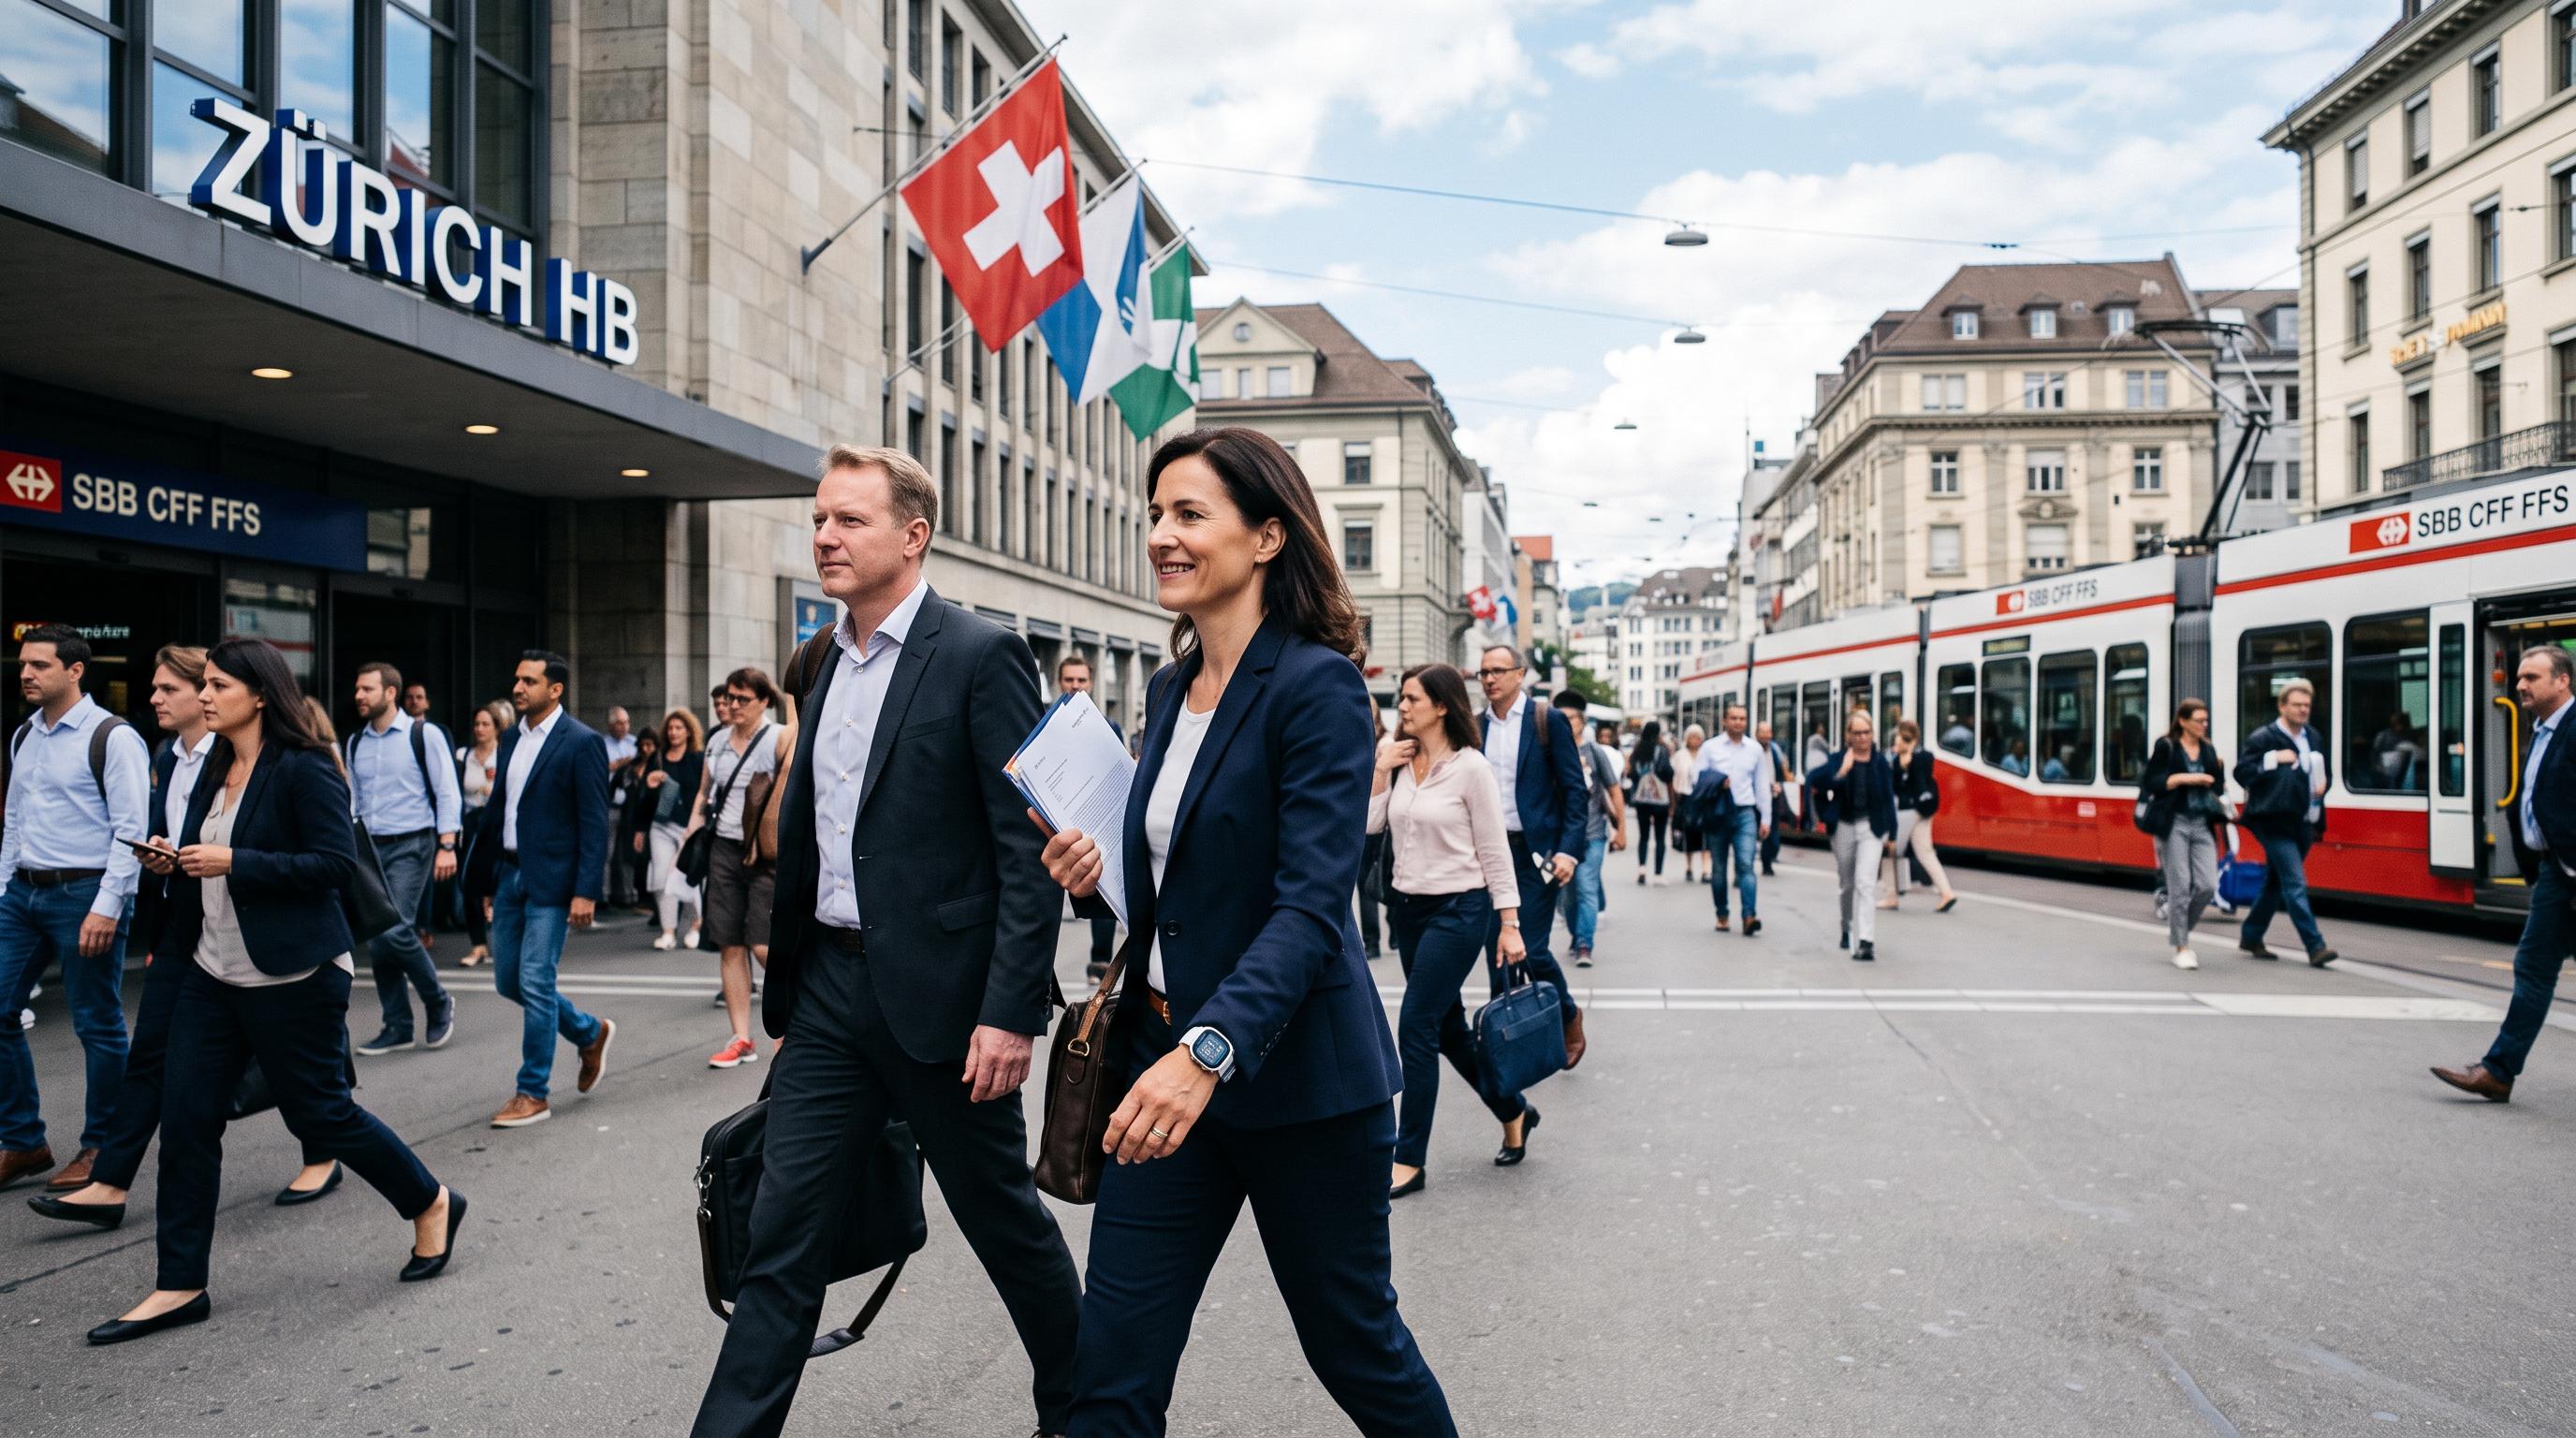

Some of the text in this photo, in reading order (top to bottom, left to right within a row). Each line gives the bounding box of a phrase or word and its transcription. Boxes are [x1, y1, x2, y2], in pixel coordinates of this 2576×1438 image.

[191, 97, 639, 366] ZÜRICH HB
[72, 473, 261, 536] SBB CFF FFS
[2418, 485, 2569, 537] SBB CFF FFS
[2052, 583, 2073, 603] CFF
[2076, 579, 2098, 600] FFS
